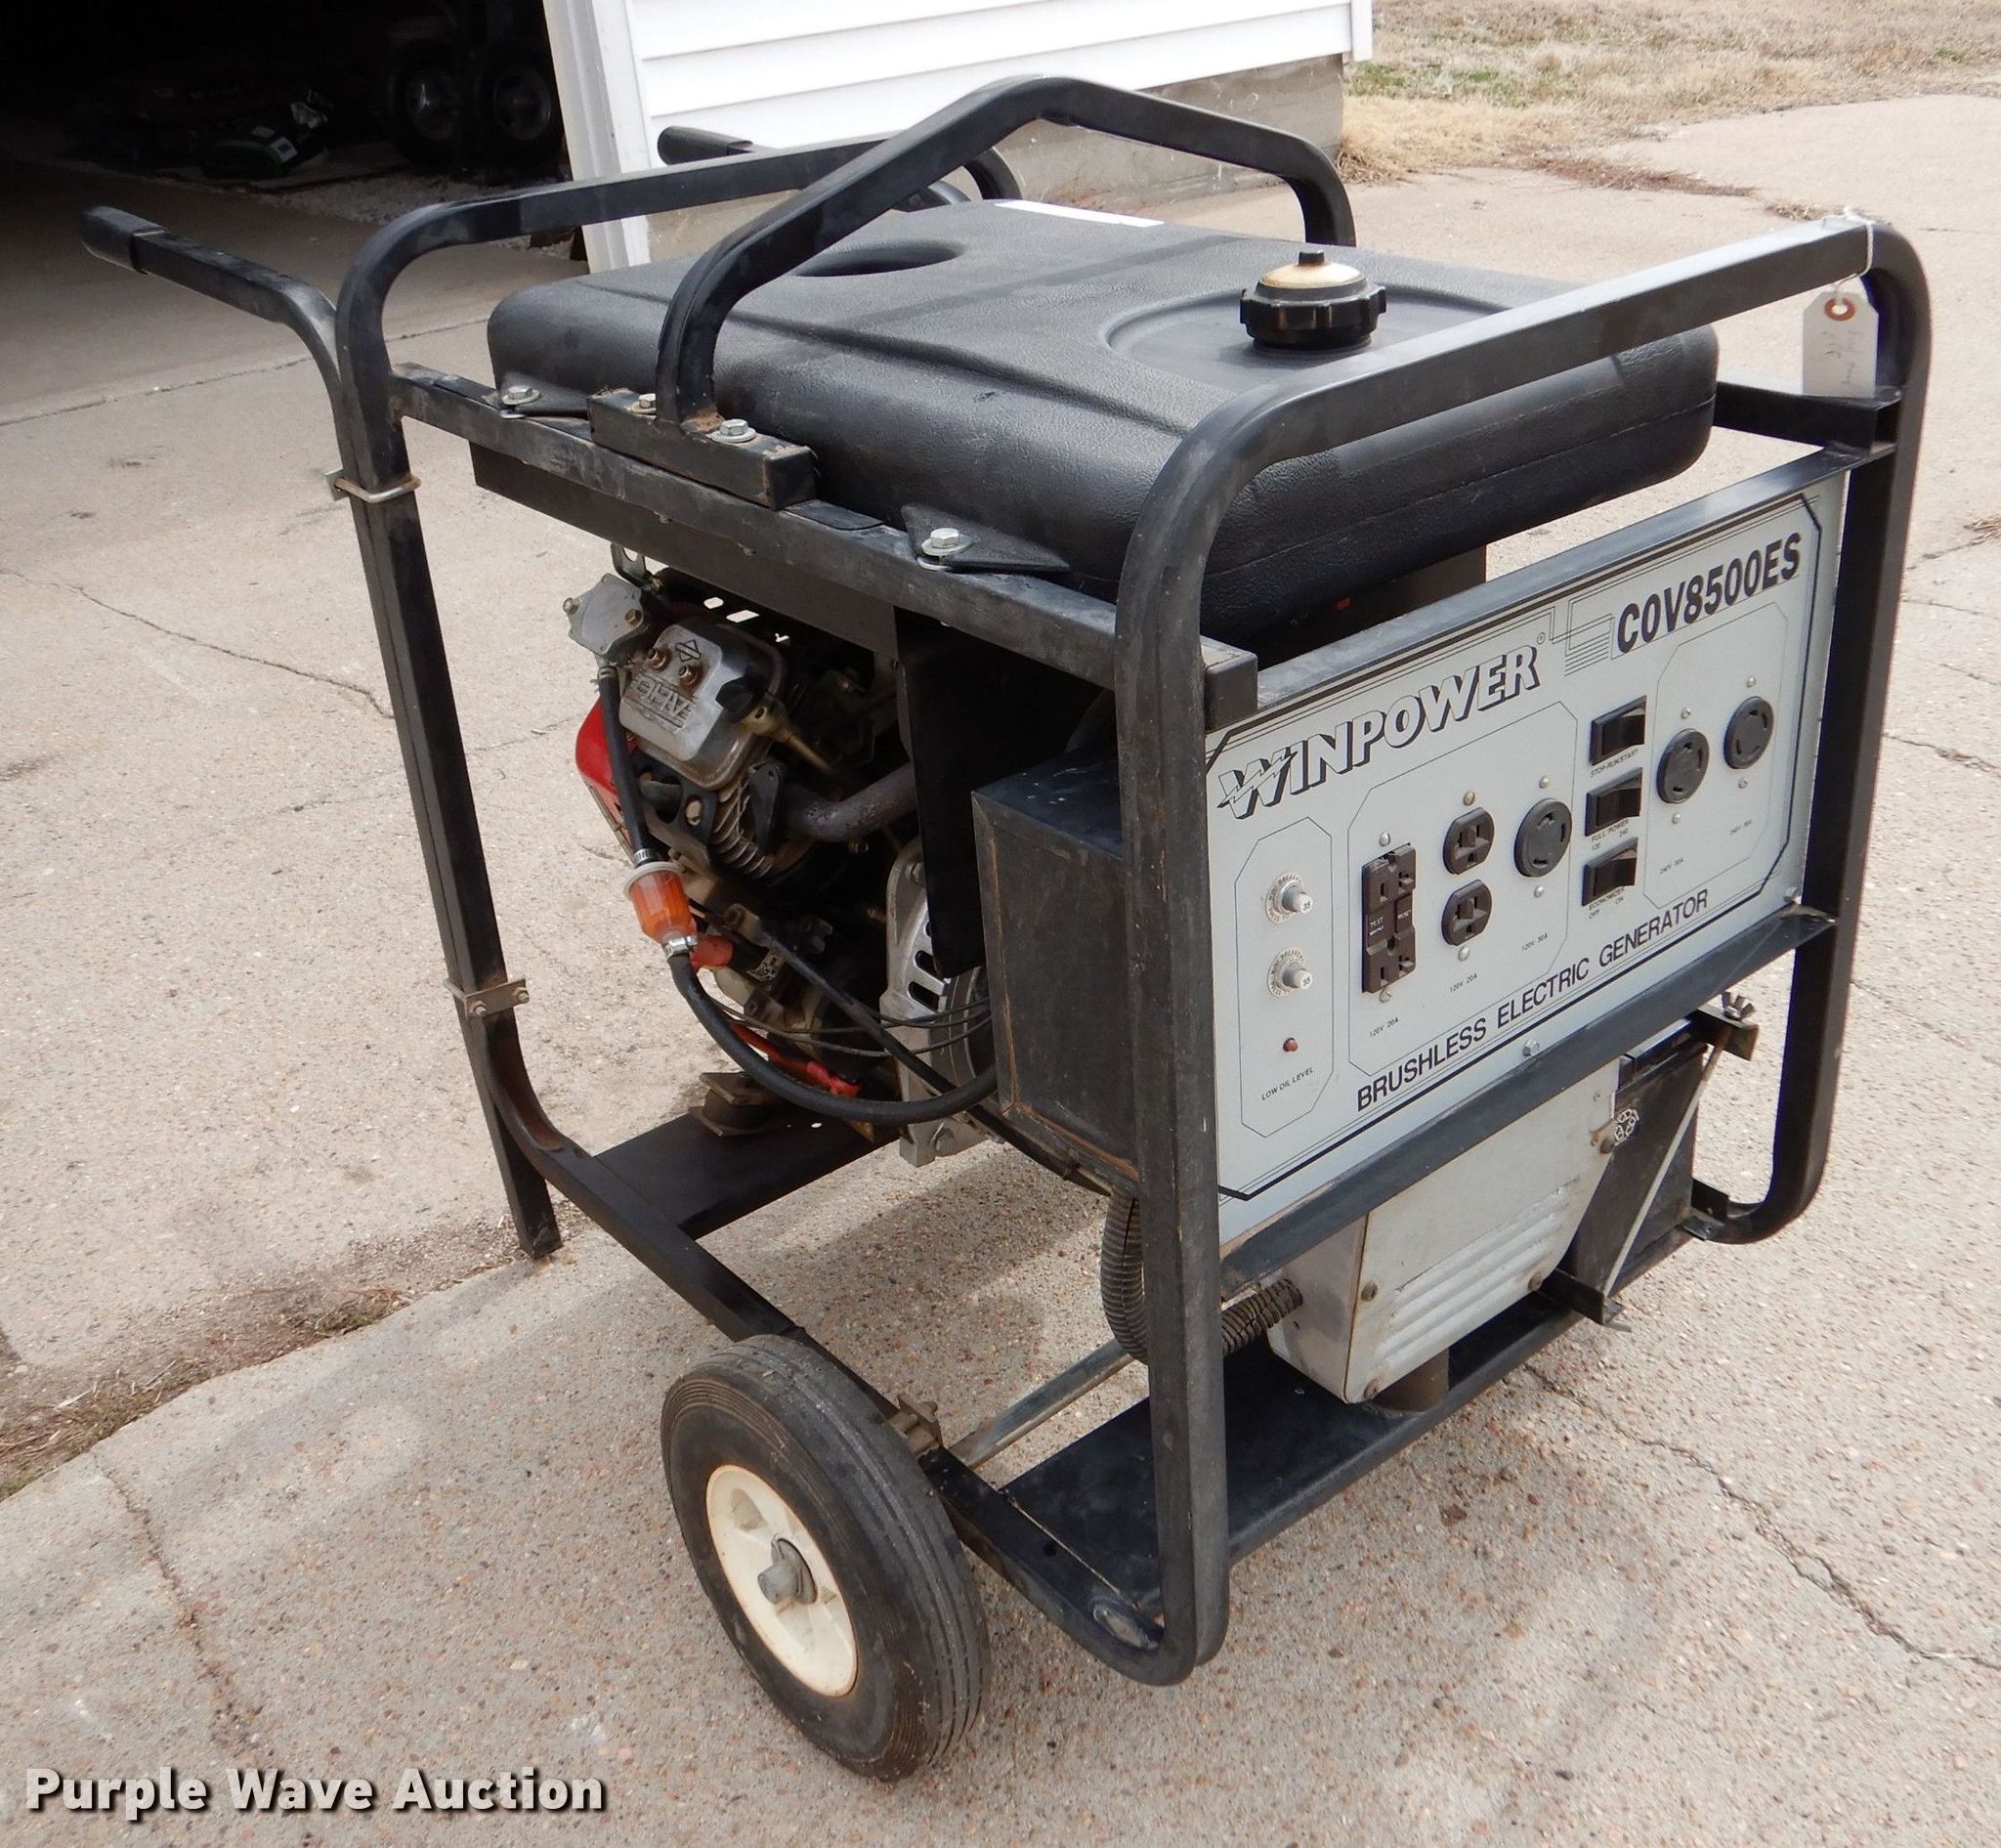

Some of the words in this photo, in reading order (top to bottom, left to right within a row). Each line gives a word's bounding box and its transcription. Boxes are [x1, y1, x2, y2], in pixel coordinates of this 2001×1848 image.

[1617, 532, 1802, 654] COV8500ES
[1217, 644, 1541, 819] WINPOWER
[1357, 1017, 1486, 1112] BRUSHLESS
[1498, 958, 1591, 1029] ELECTRIC
[1598, 888, 1709, 967] GENERATOR
[1261, 1087, 1278, 1101] LOW
[1279, 1080, 1291, 1091] OIL
[1292, 1067, 1314, 1084] LEVEL
